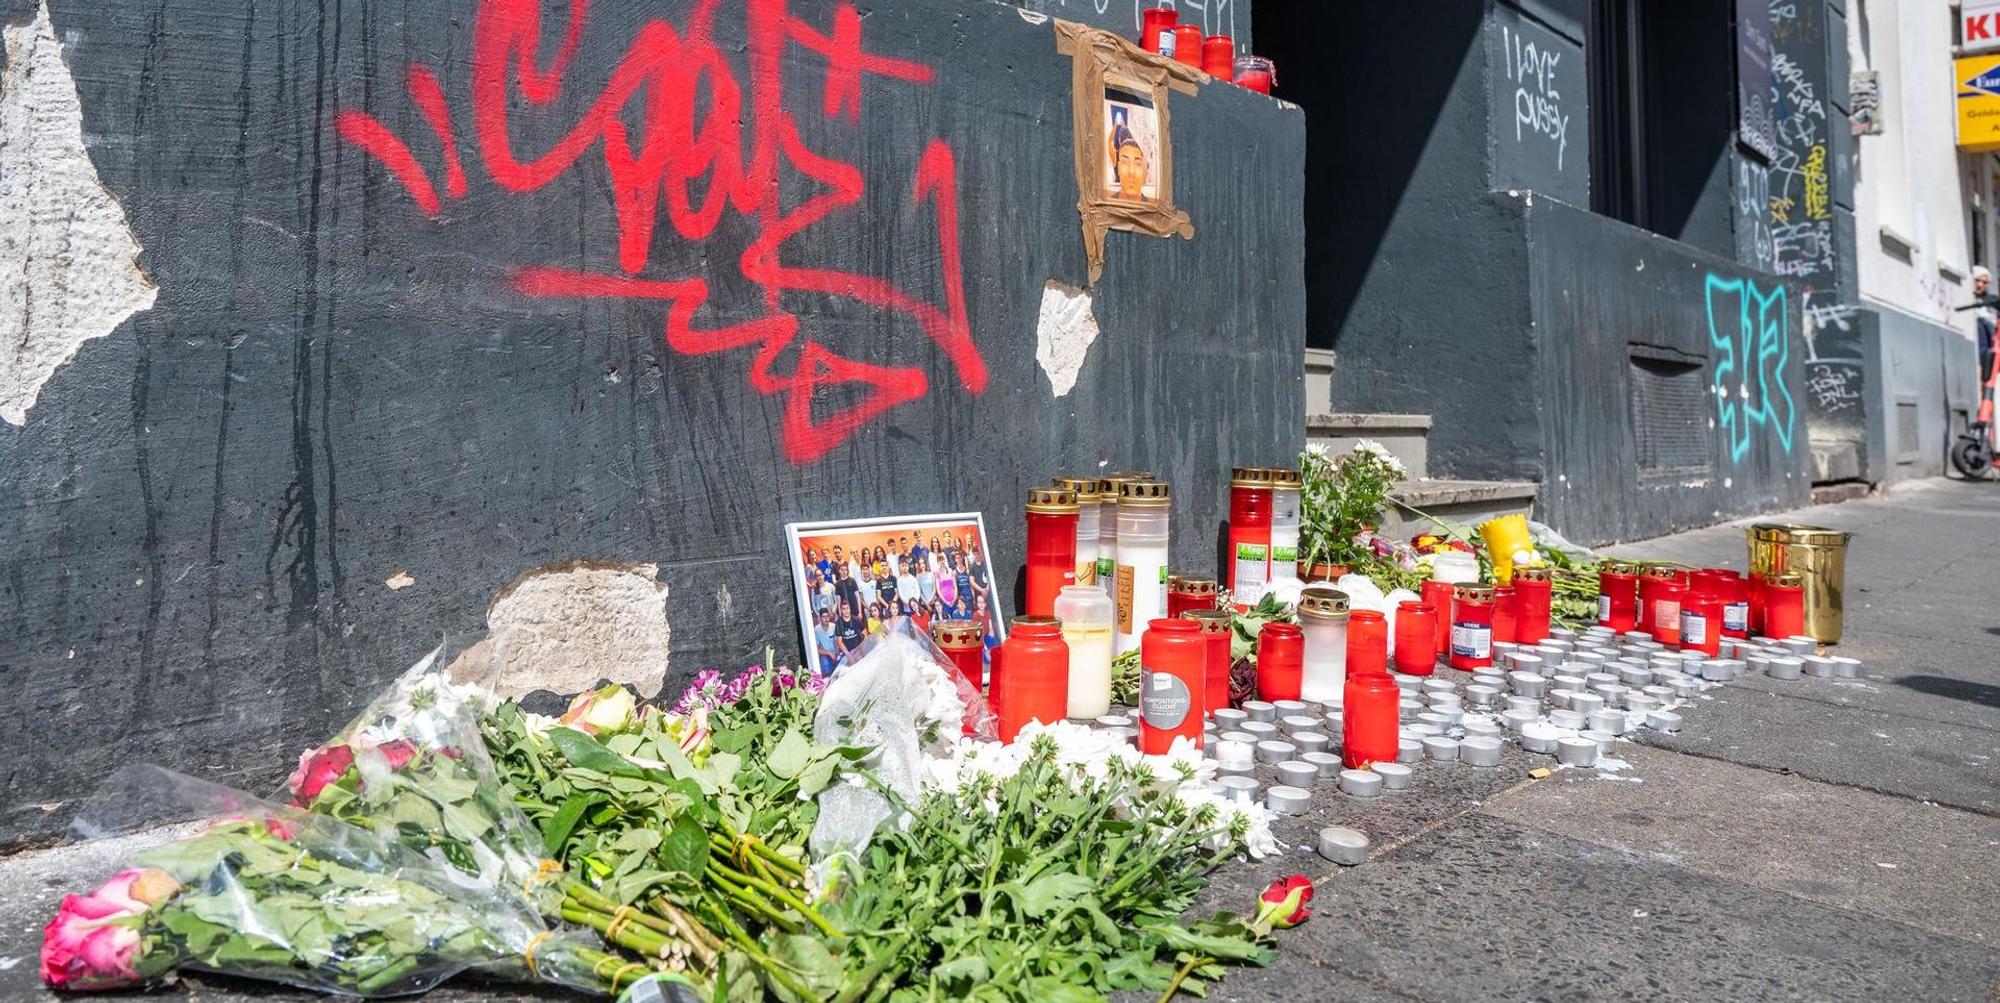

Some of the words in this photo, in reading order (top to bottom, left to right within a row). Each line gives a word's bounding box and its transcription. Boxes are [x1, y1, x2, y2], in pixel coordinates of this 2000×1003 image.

[1503, 26, 1512, 79] I
[1515, 34, 1561, 100] LOVE
[1516, 88, 1569, 171] PUSSY
